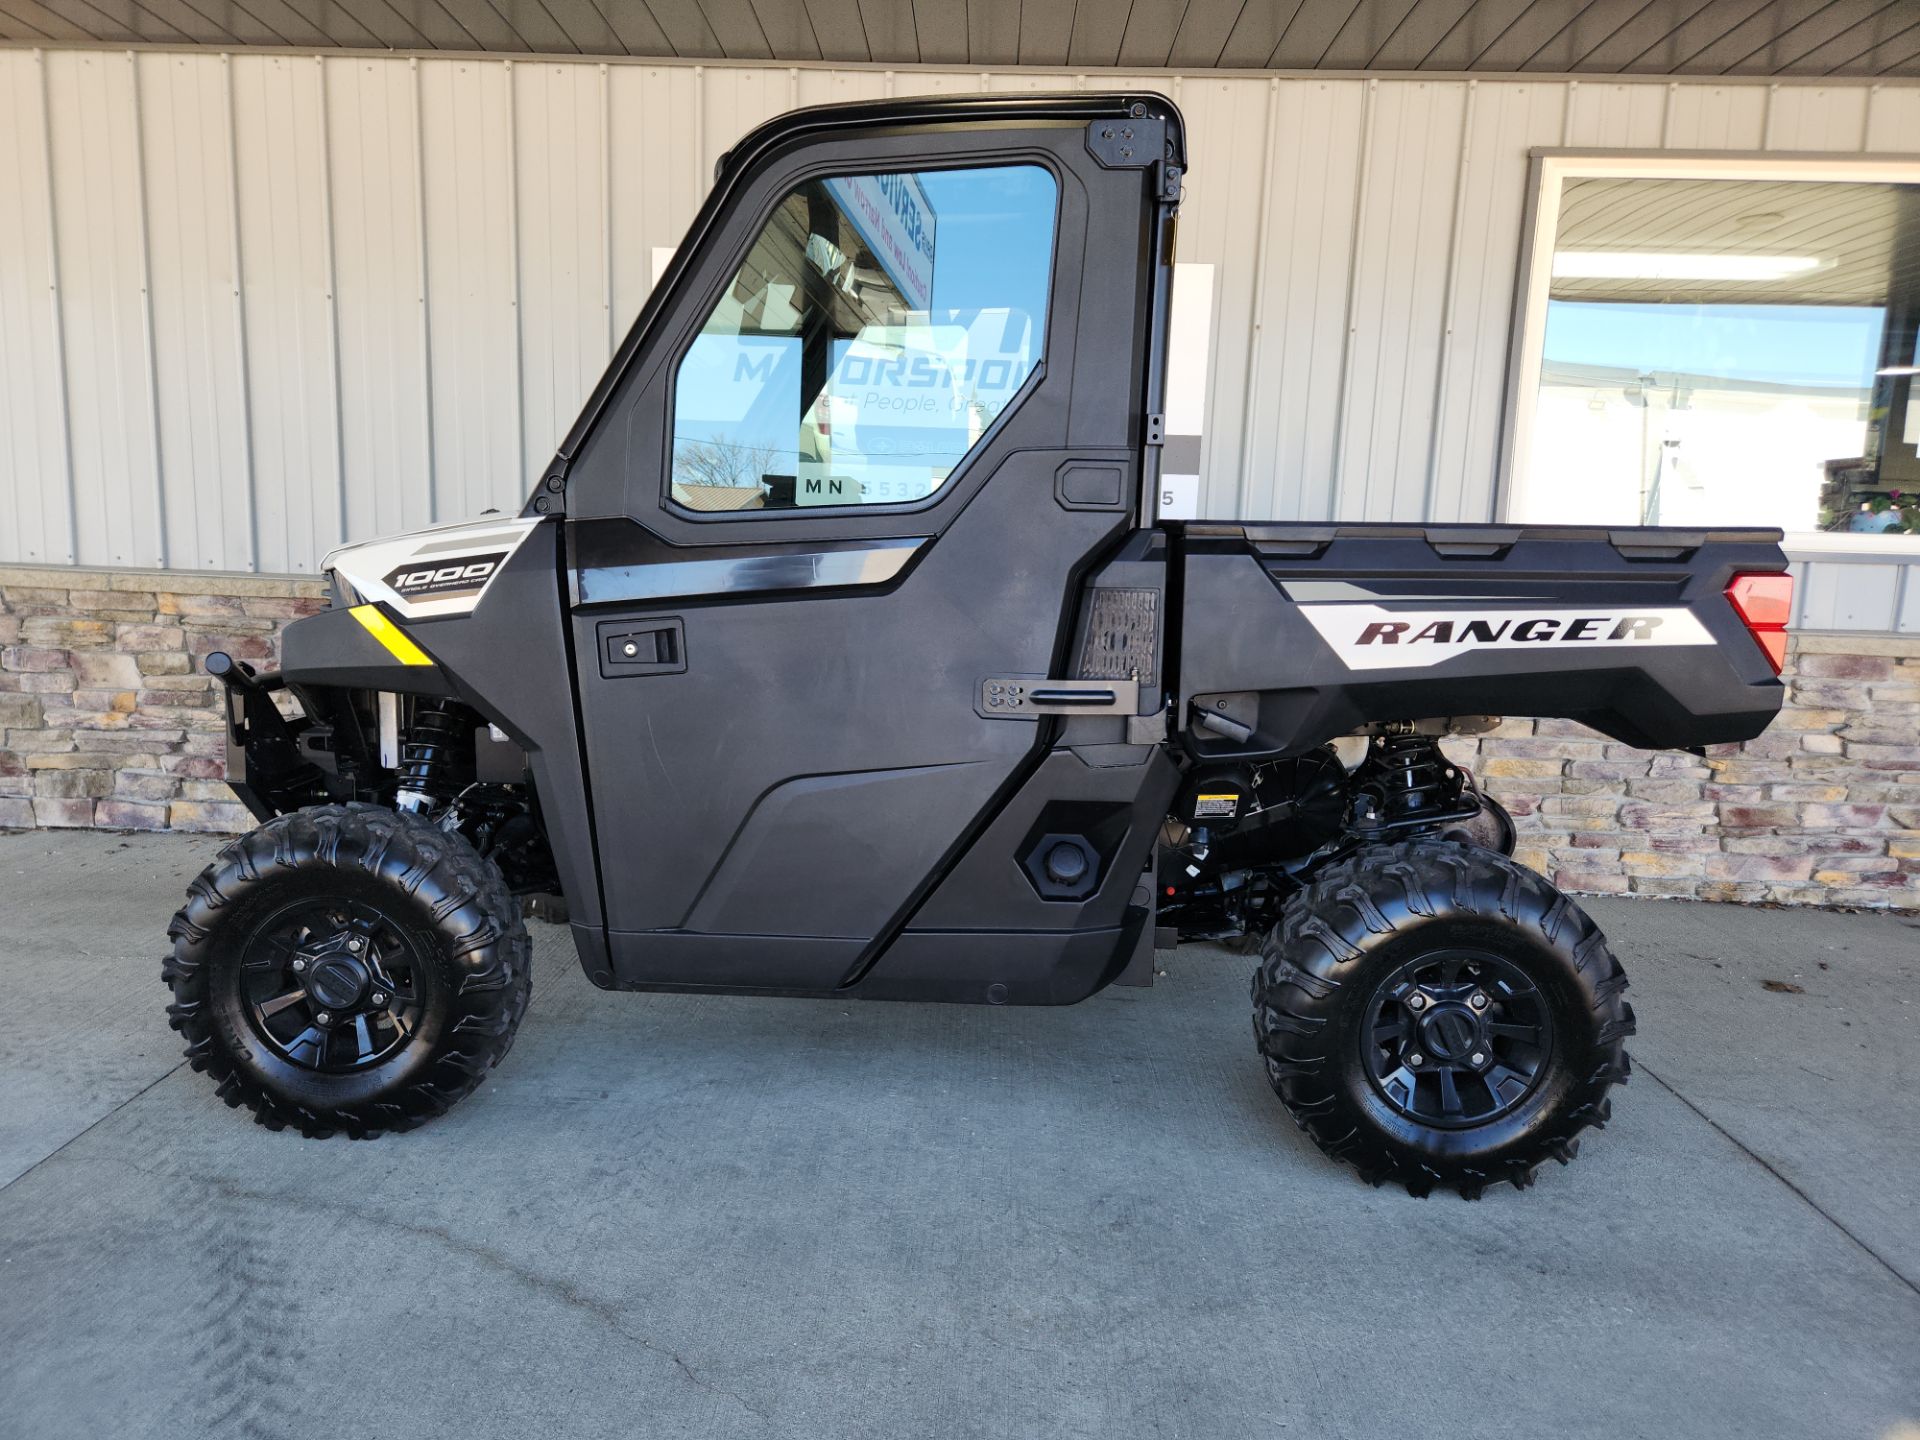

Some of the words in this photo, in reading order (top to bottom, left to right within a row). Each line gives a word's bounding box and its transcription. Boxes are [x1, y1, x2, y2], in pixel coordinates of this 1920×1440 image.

[733, 353, 1031, 390] MORSPO
[863, 391, 939, 413] People,
[805, 478, 843, 495] MN
[859, 480, 927, 497] 5532
[394, 562, 495, 588] 1000
[1354, 616, 1664, 646] RANGER
